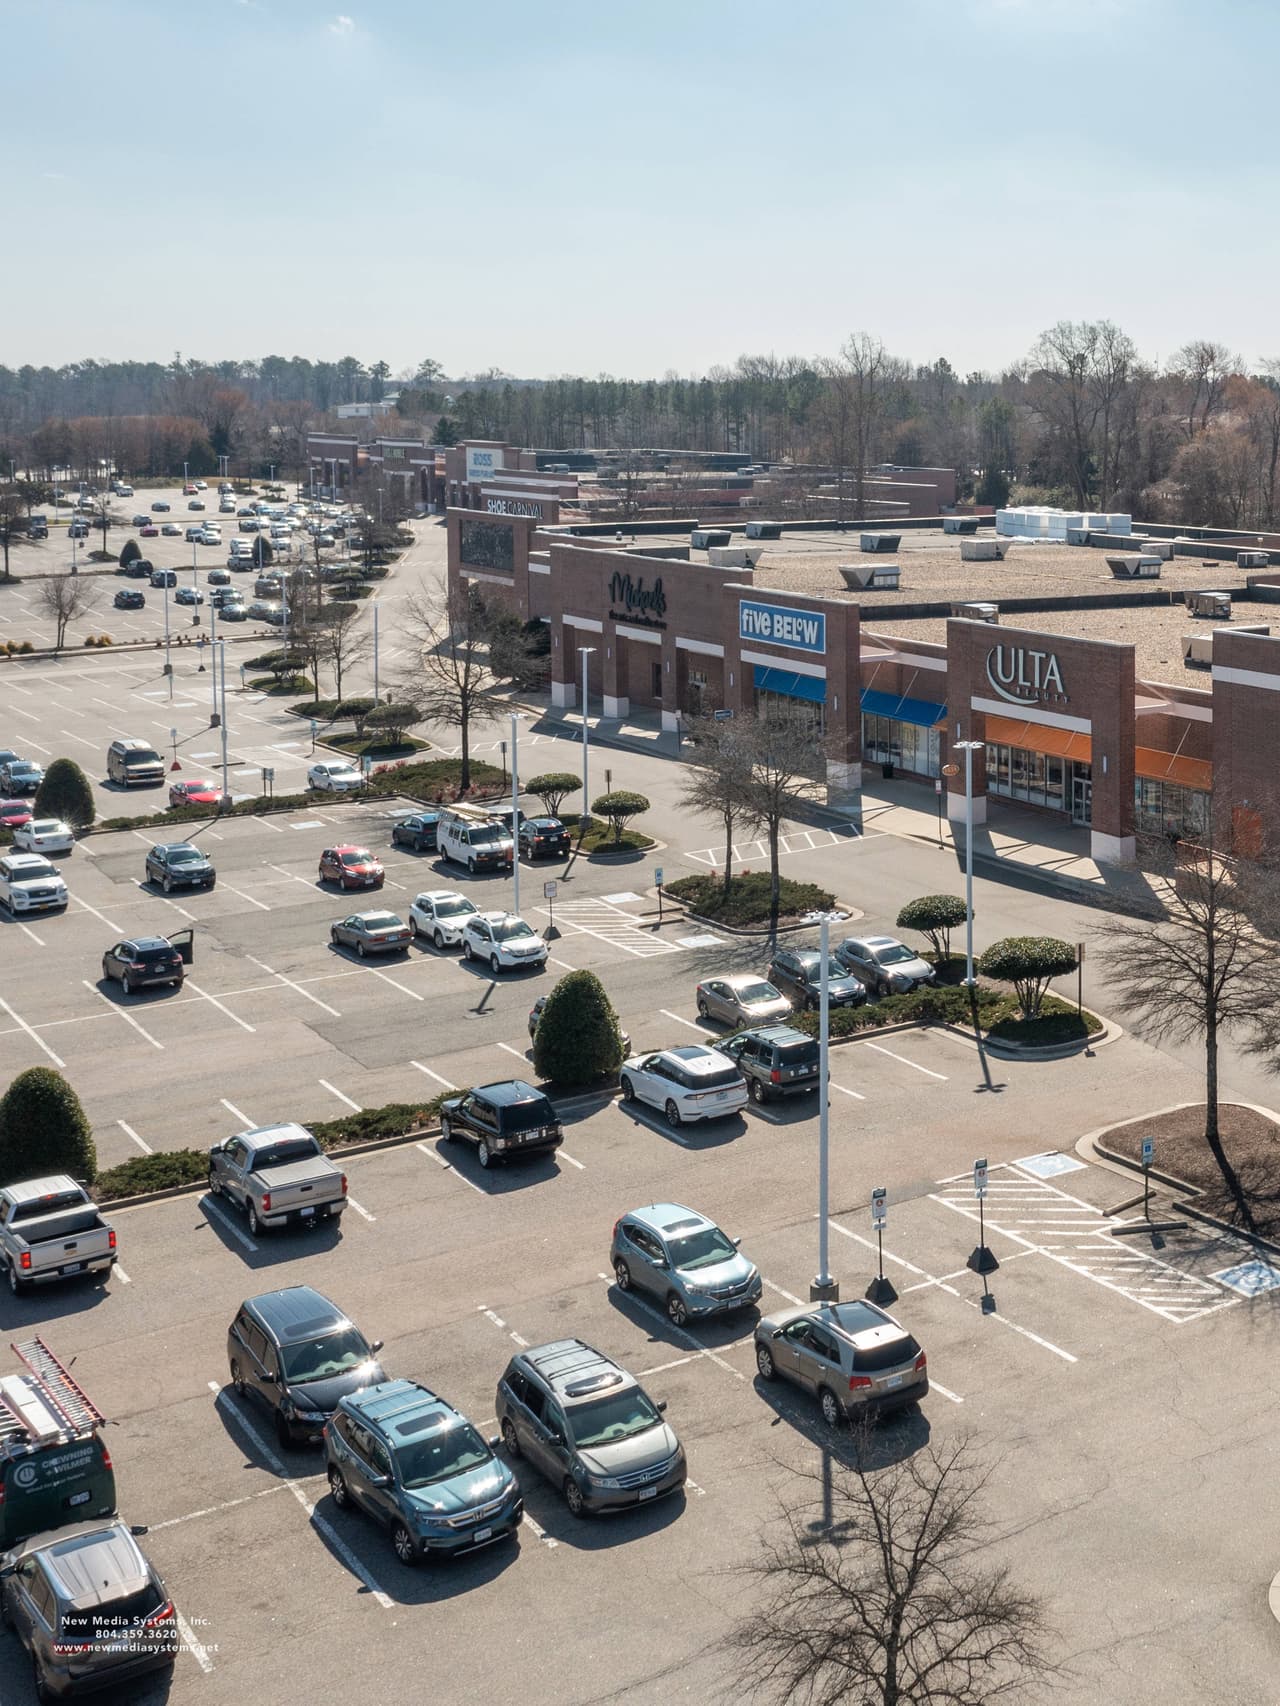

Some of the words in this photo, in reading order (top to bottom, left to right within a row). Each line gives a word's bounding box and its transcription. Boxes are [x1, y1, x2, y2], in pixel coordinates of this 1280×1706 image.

[487, 499, 506, 514] SHOE
[507, 500, 543, 519] CARNIVAL
[994, 645, 1064, 693] ULTA
